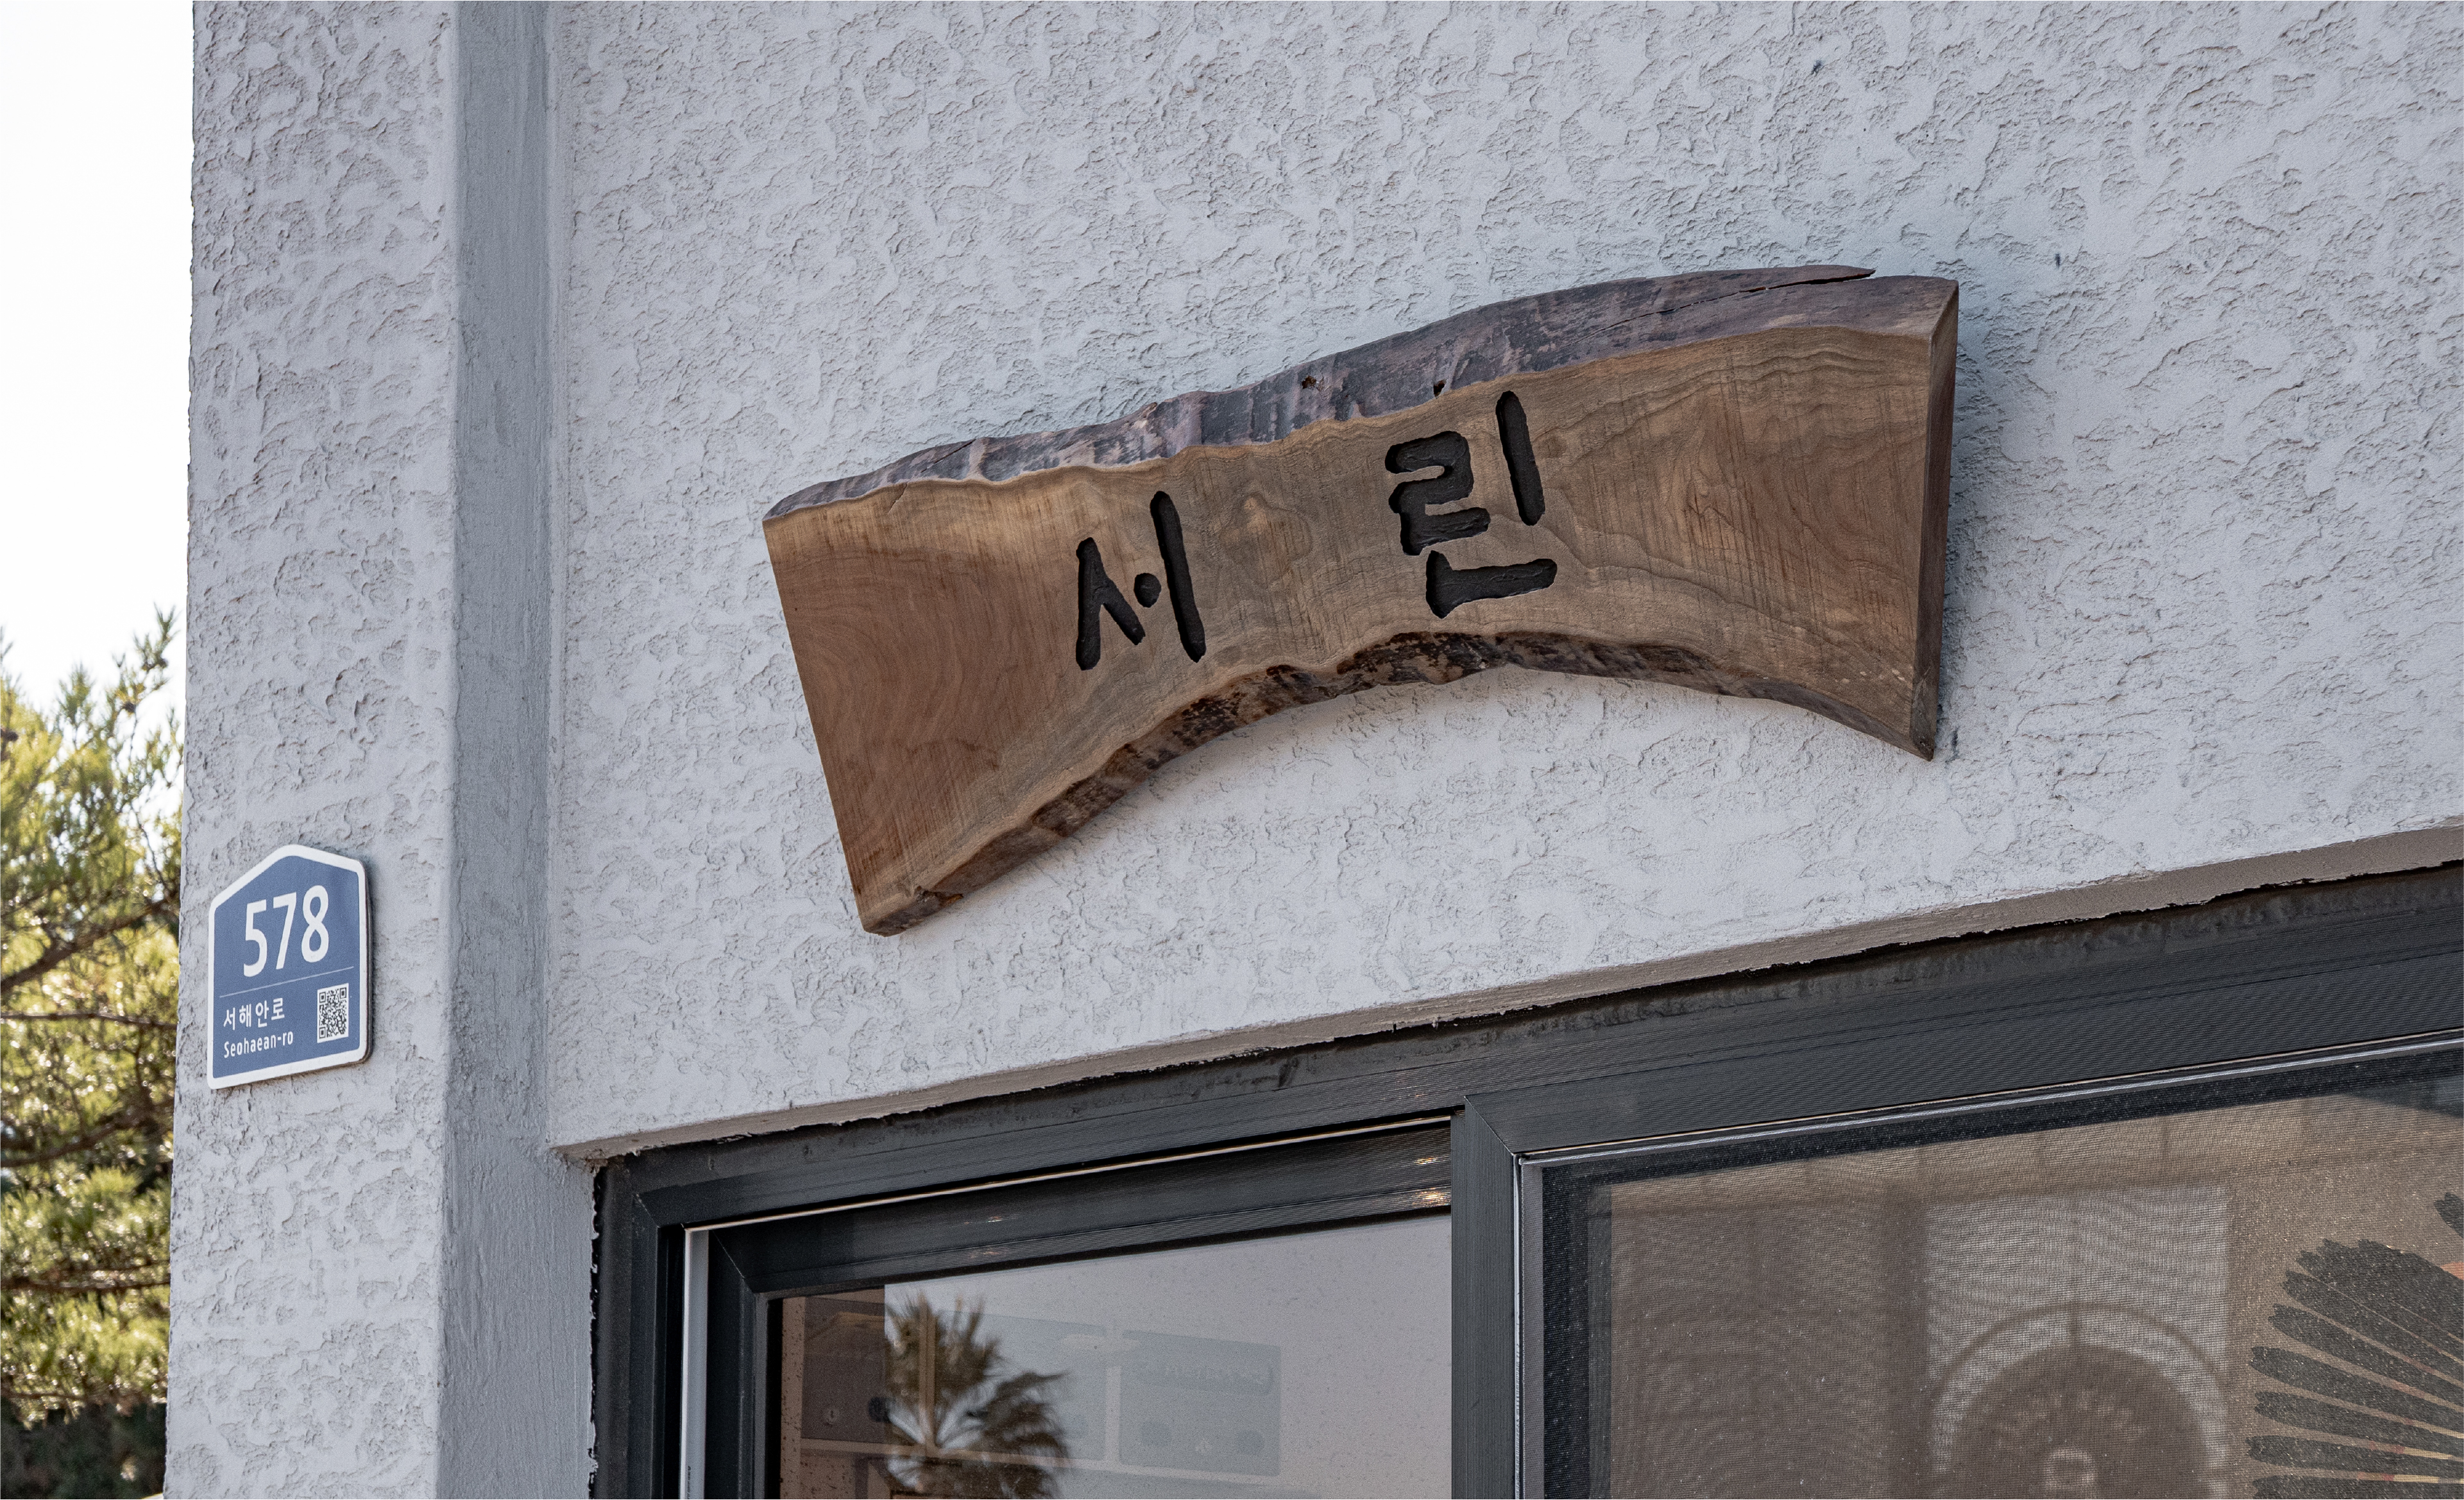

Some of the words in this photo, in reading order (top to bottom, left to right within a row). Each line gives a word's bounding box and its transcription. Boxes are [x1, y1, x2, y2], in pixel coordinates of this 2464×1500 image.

[243, 885, 329, 977] 578
[223, 997, 285, 1031] 서해안로
[224, 1031, 294, 1059] Seohaean-ro
